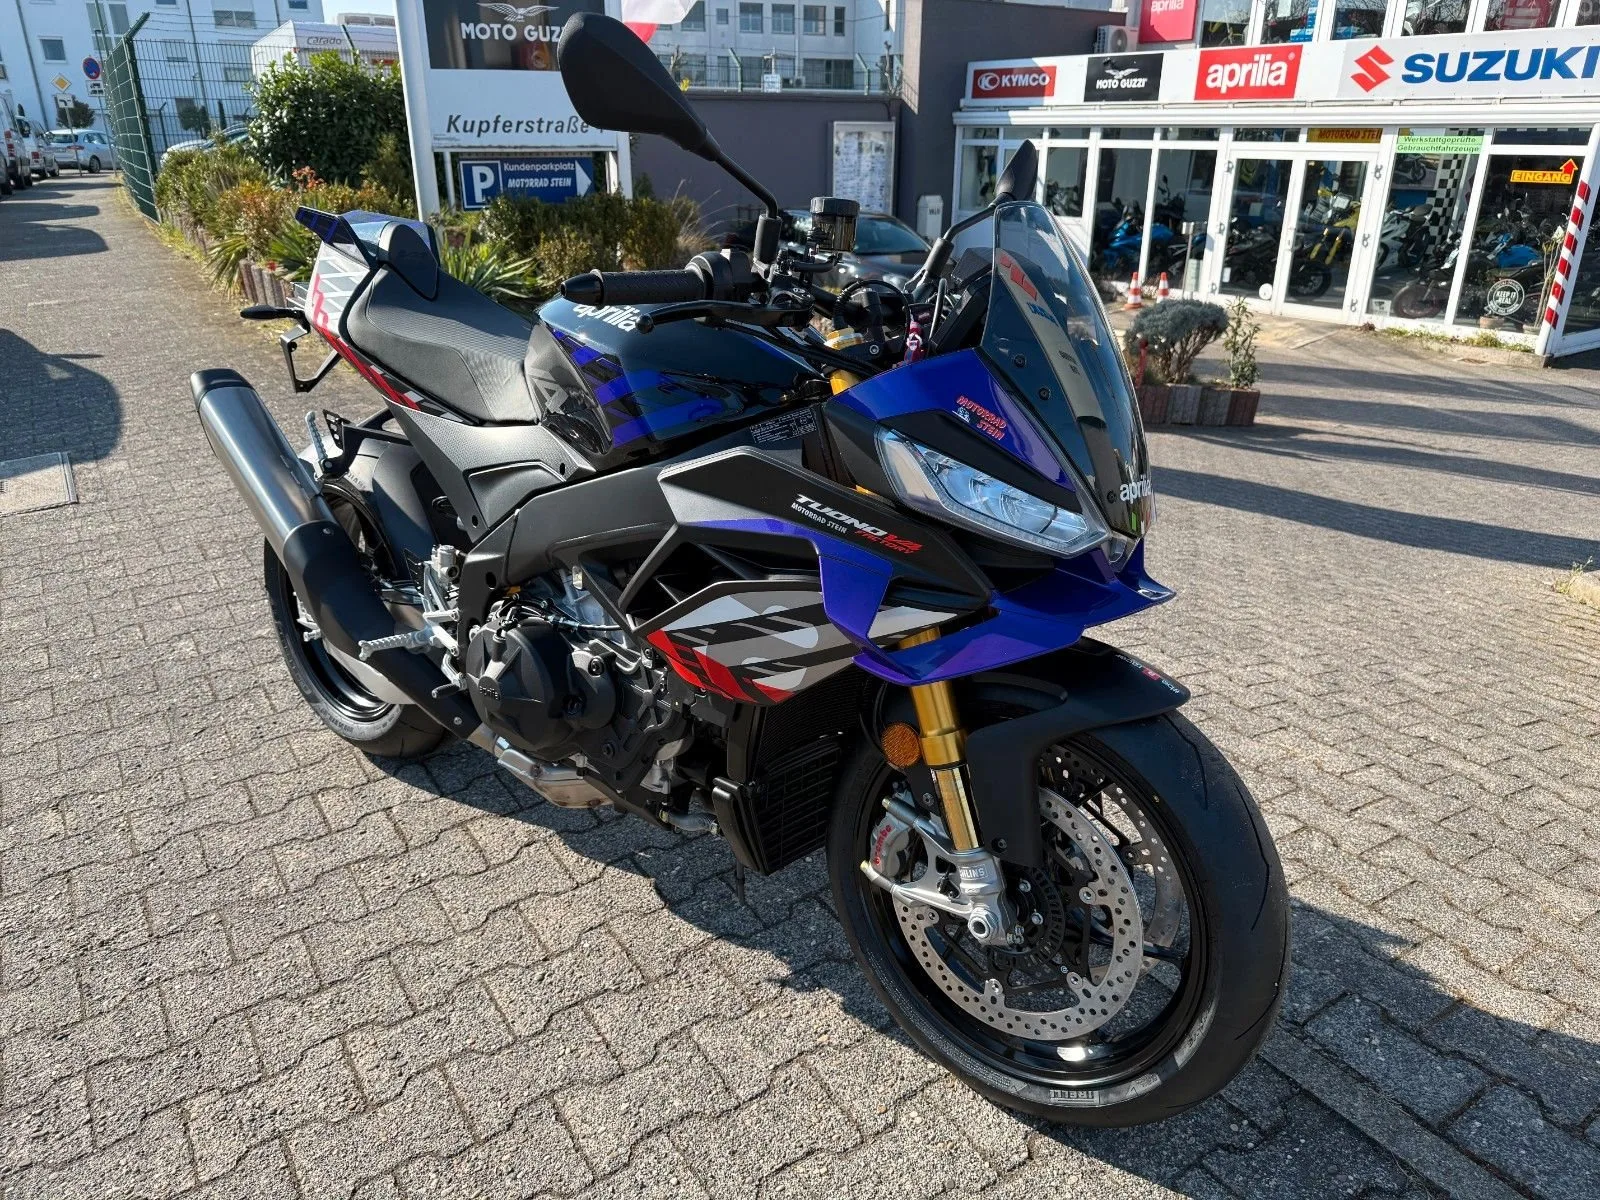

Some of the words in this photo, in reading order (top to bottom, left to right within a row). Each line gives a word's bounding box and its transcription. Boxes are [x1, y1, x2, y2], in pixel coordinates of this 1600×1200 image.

[460, 22, 517, 41] MOTO
[523, 24, 566, 43] GUZ
[1205, 53, 1288, 94] aprilia
[1401, 45, 1600, 84] SUZUKI
[1001, 73, 1050, 88] KYMCO
[1095, 78, 1119, 89] MOTO
[1120, 77, 1148, 89] GUZZI
[446, 114, 590, 138] Kupferstraße
[1396, 144, 1480, 153] Gebrauchtfahrzeuge
[503, 162, 575, 172] Kundenparkplatz
[1513, 171, 1571, 182] EINGANG
[471, 165, 495, 203] P
[550, 177, 572, 188] STEIN
[956, 395, 1007, 429] MOTORRAD
[976, 420, 1006, 441] STEIN
[790, 502, 827, 525] MOTORRAD
[826, 520, 849, 535] STEIN
[796, 493, 888, 537] TUONO
